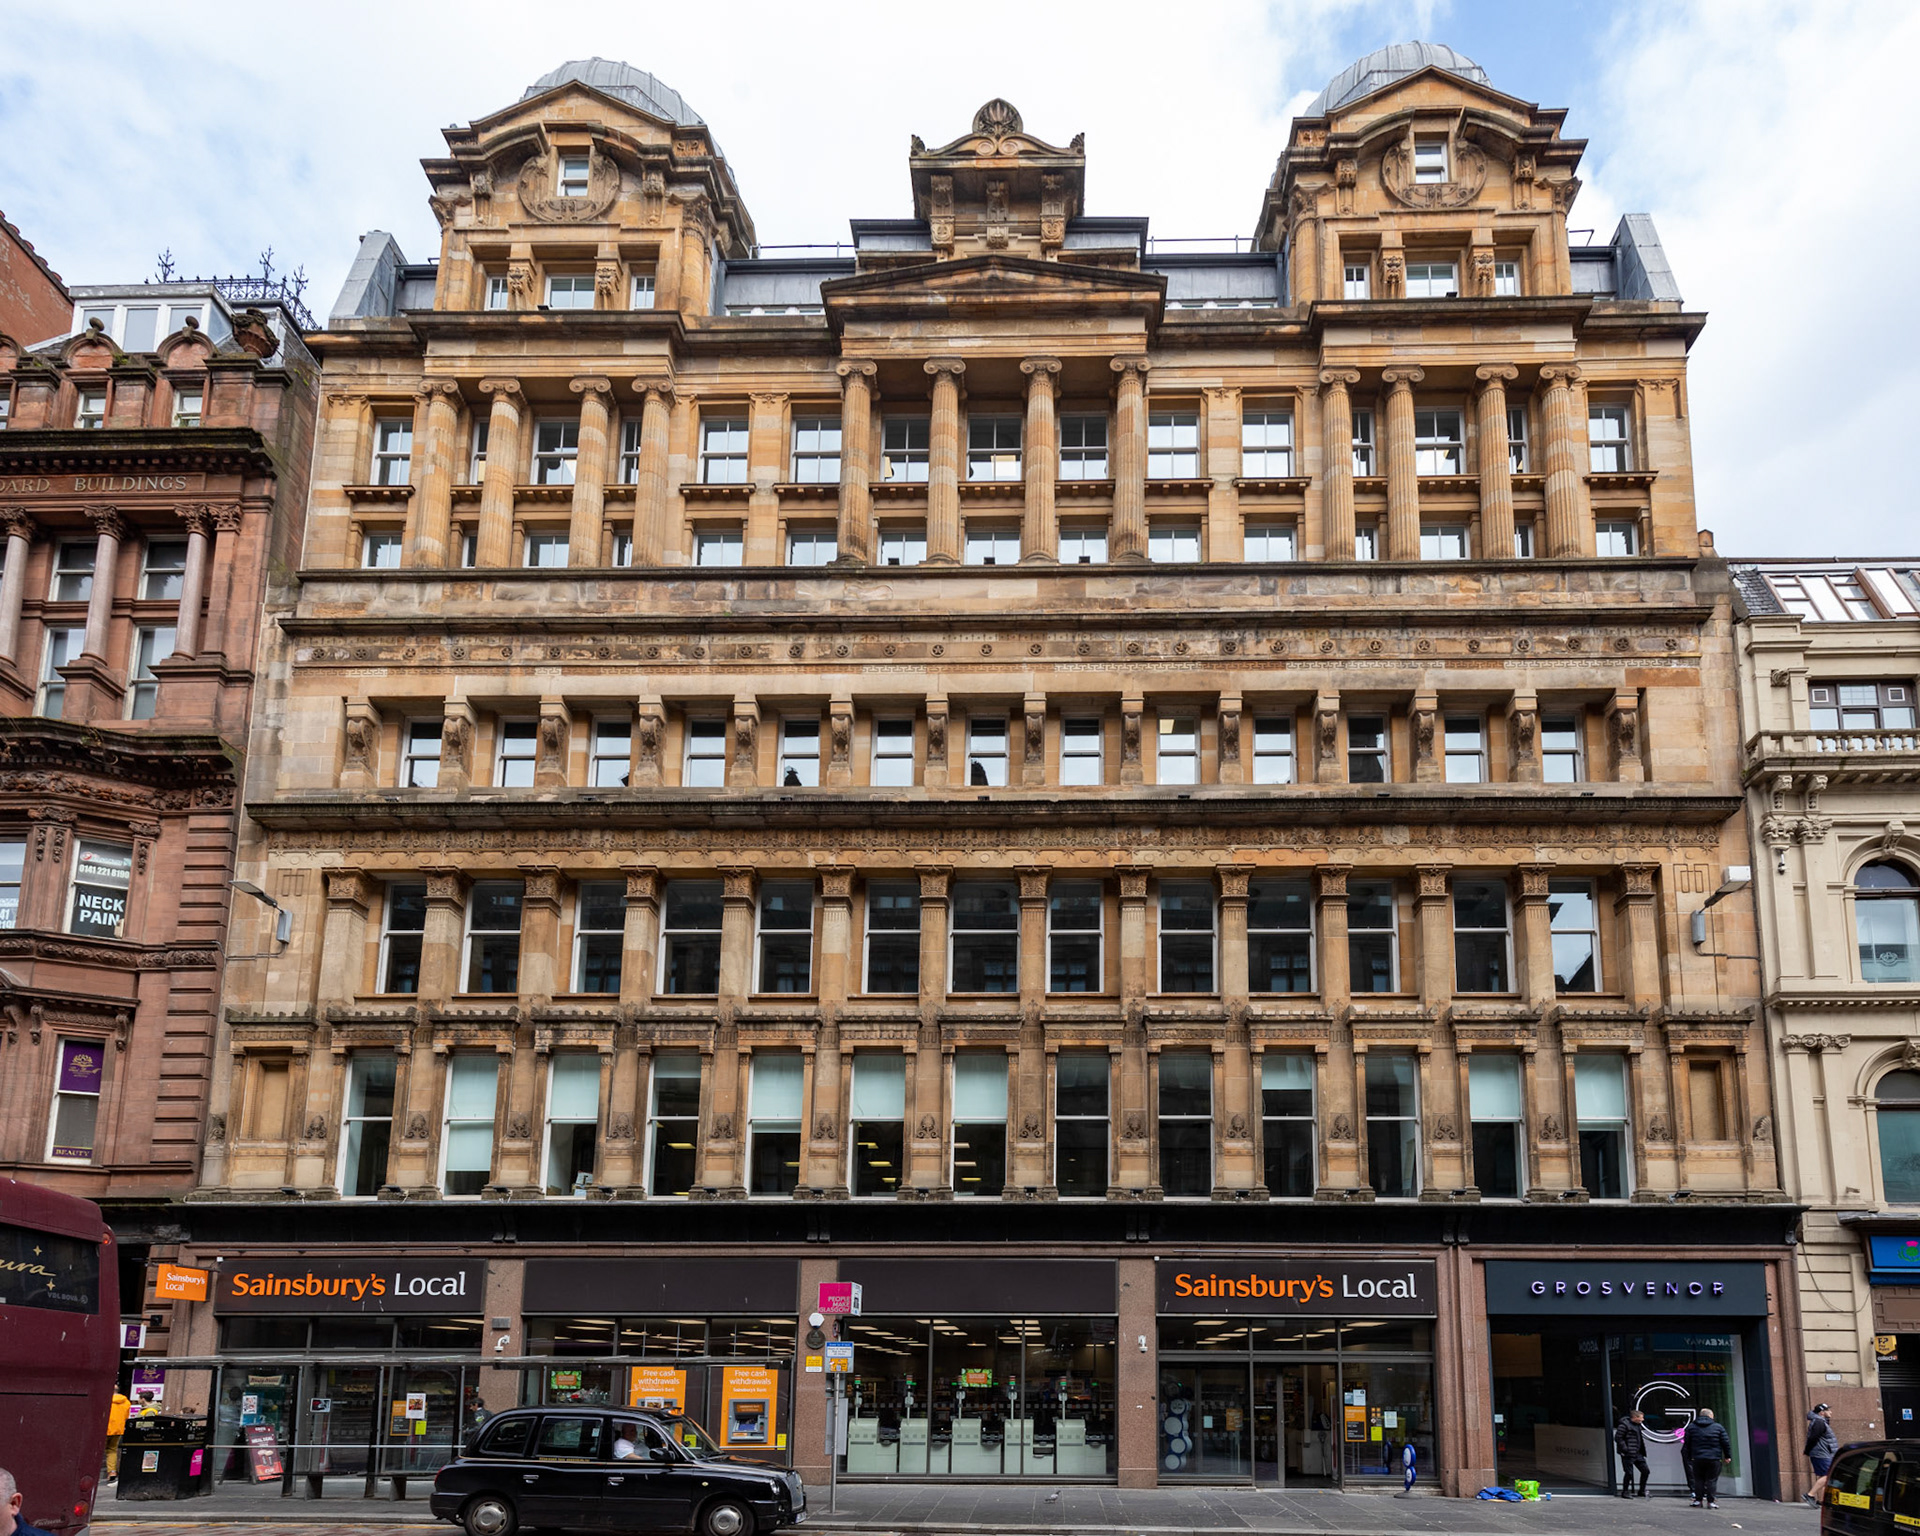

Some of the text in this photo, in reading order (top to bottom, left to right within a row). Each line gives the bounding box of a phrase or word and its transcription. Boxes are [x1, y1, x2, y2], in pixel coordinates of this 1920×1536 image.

[74, 476, 187, 491] BUILDINGS
[79, 864, 97, 874] 0141
[97, 866, 110, 876] 221
[79, 894, 125, 912] NECK
[80, 910, 120, 926] PAIN
[55, 1149, 90, 1157] BEAUTY
[165, 1282, 185, 1291] Local
[166, 1272, 206, 1286] Sainsbury's
[231, 1271, 466, 1301] Sainsbury's Local
[1174, 1273, 1417, 1303] Sainsbury's Local
[1531, 1280, 1724, 1295] GROSVENOR
[638, 1377, 680, 1385] withdrawals
